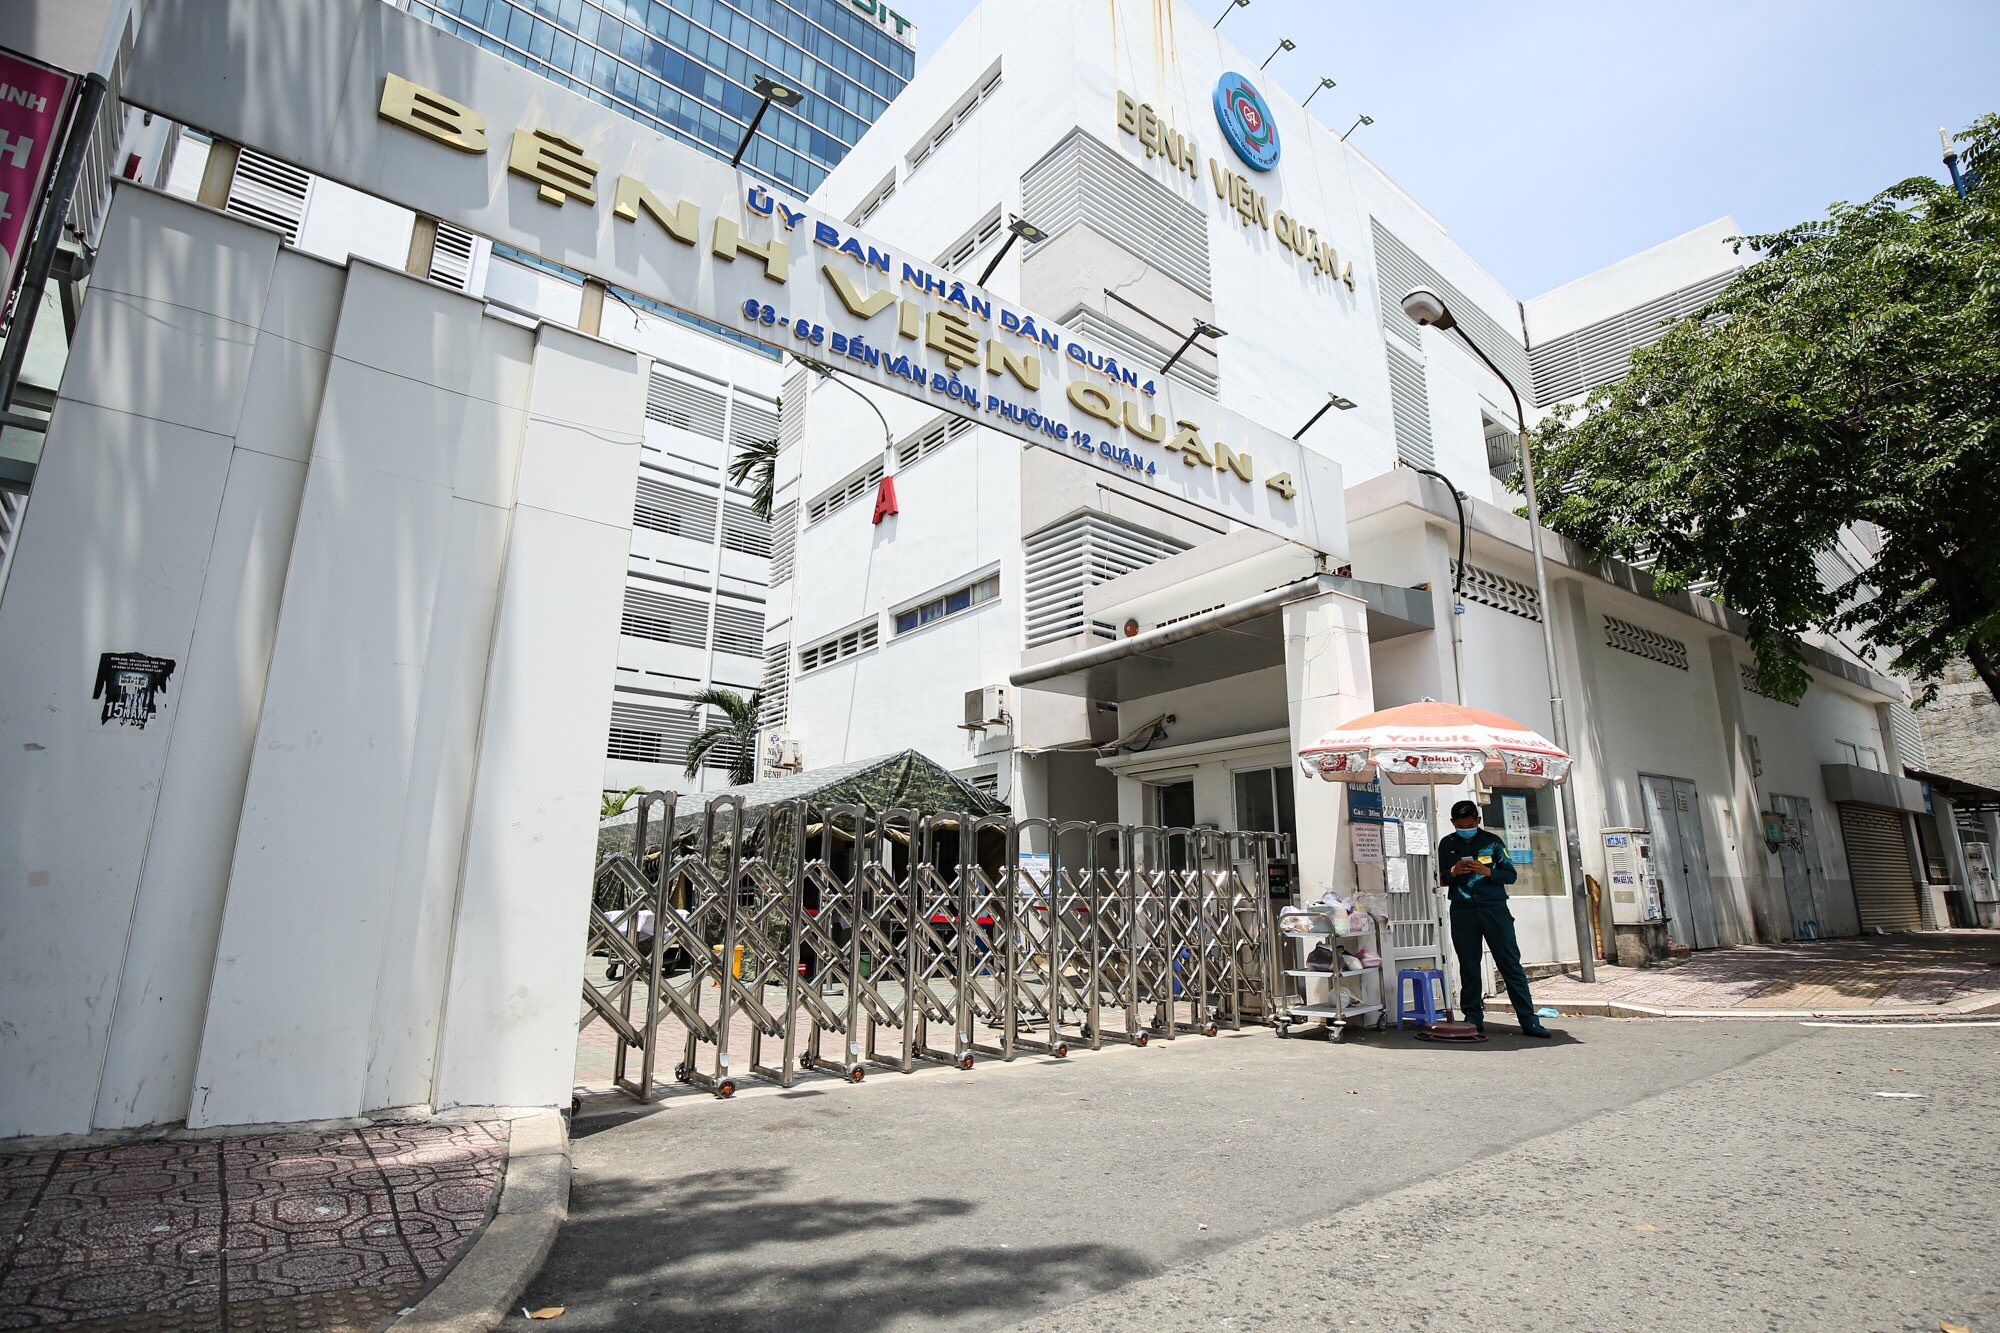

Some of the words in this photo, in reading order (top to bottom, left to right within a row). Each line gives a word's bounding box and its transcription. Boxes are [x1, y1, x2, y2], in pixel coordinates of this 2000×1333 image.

[1117, 89, 1198, 180] BỆNH
[1209, 157, 1269, 231] VIỆN
[1273, 209, 1339, 280] QUẬN
[1343, 261, 1356, 292] 4
[378, 73, 790, 284] BỆNH
[822, 264, 1041, 391] VIỆN
[1066, 380, 1254, 483] QUẬN
[1265, 472, 1297, 500] 4
[746, 185, 807, 231] ỦY
[813, 220, 890, 275] BAN
[900, 262, 991, 321] NHÂN
[999, 308, 1059, 352] DÂN
[1065, 342, 1138, 390] QUẬN
[1141, 380, 1157, 397] 4
[743, 299, 776, 327] 63
[794, 318, 825, 346] 65
[829, 335, 879, 368] BẾN
[882, 351, 927, 387] VÂN
[930, 372, 981, 409] ĐỒN,
[985, 395, 1069, 442] PHƯỜNG
[1071, 430, 1095, 453] 12,
[1097, 440, 1144, 471] QUẬN
[1143, 460, 1157, 477] 4
[106, 701, 125, 717] 15
[1319, 735, 1371, 745] Yakult
[1386, 734, 1476, 742] Yakult
[1488, 733, 1553, 750] Yakult
[1420, 754, 1460, 763] Yakult
